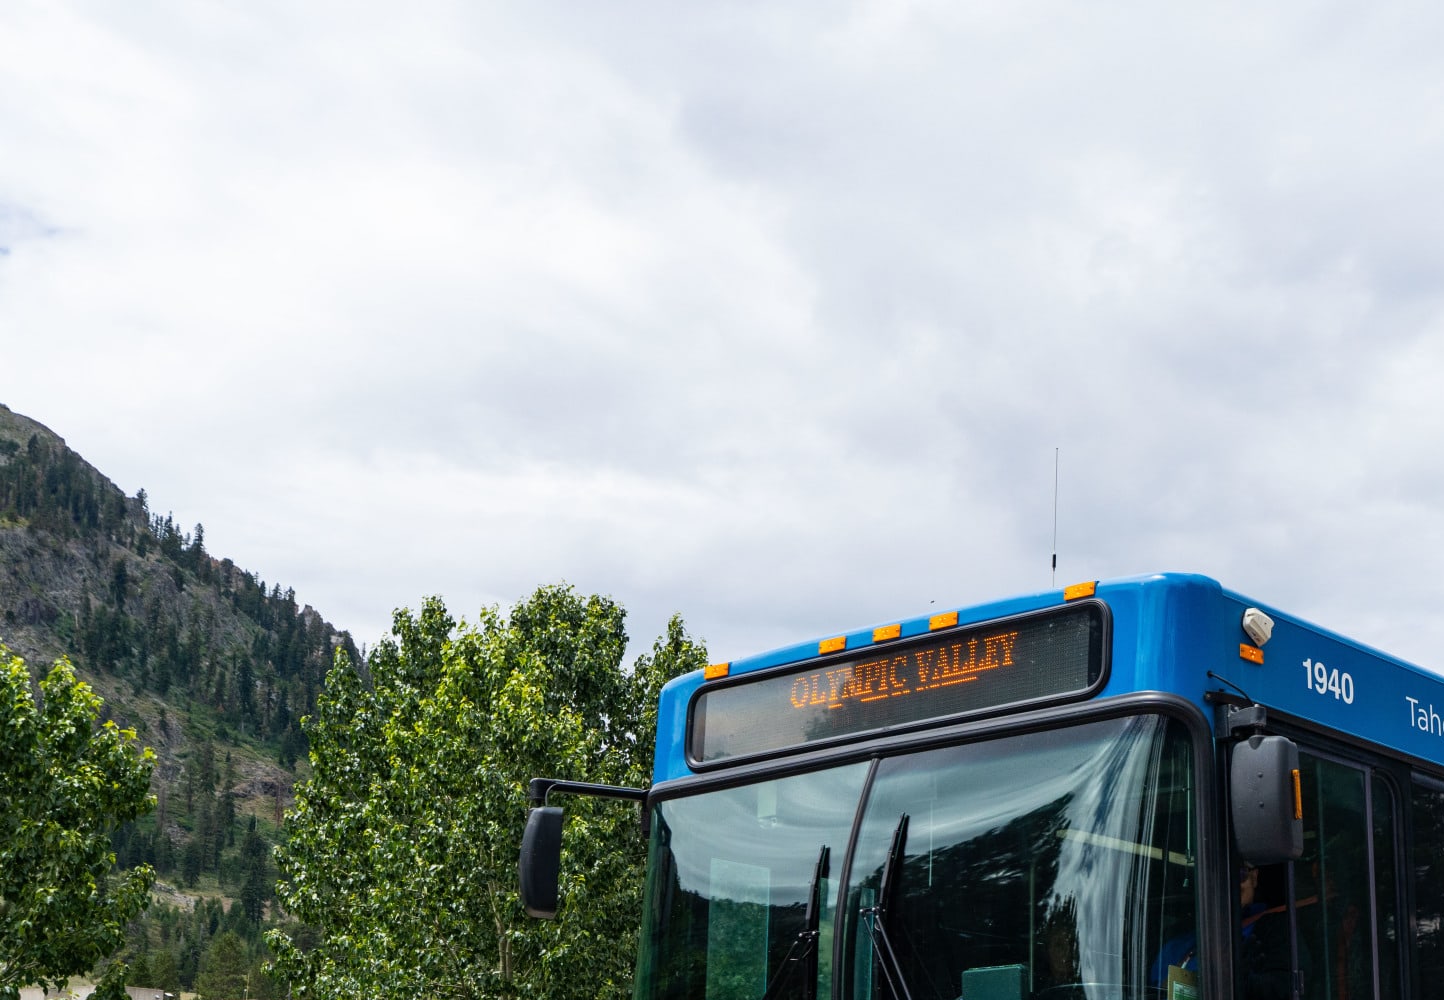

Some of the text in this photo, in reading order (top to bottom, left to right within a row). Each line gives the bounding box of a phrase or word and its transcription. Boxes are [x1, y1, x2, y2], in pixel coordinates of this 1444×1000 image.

[790, 631, 1020, 710] OLYMPIC VALLEY
[1302, 658, 1354, 705] 1940
